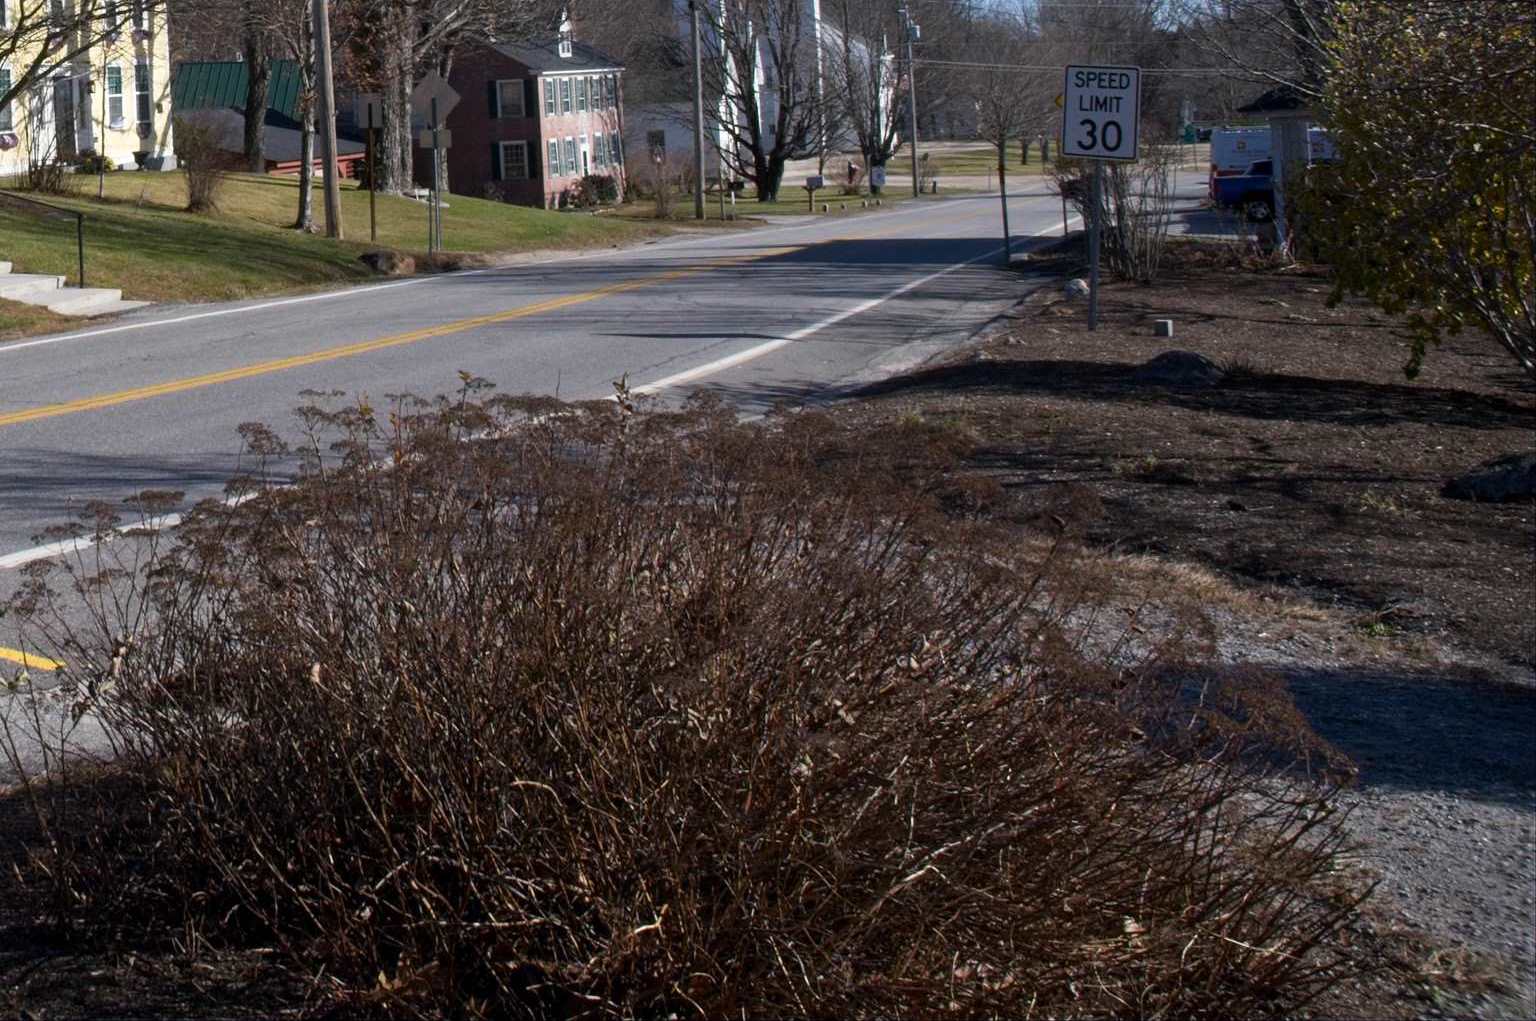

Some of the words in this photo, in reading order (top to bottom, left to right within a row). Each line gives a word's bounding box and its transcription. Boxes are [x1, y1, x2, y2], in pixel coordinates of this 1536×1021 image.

[1074, 71, 1130, 90] SPEED
[1079, 95, 1124, 113] LIMIT
[1077, 119, 1122, 152] 30
